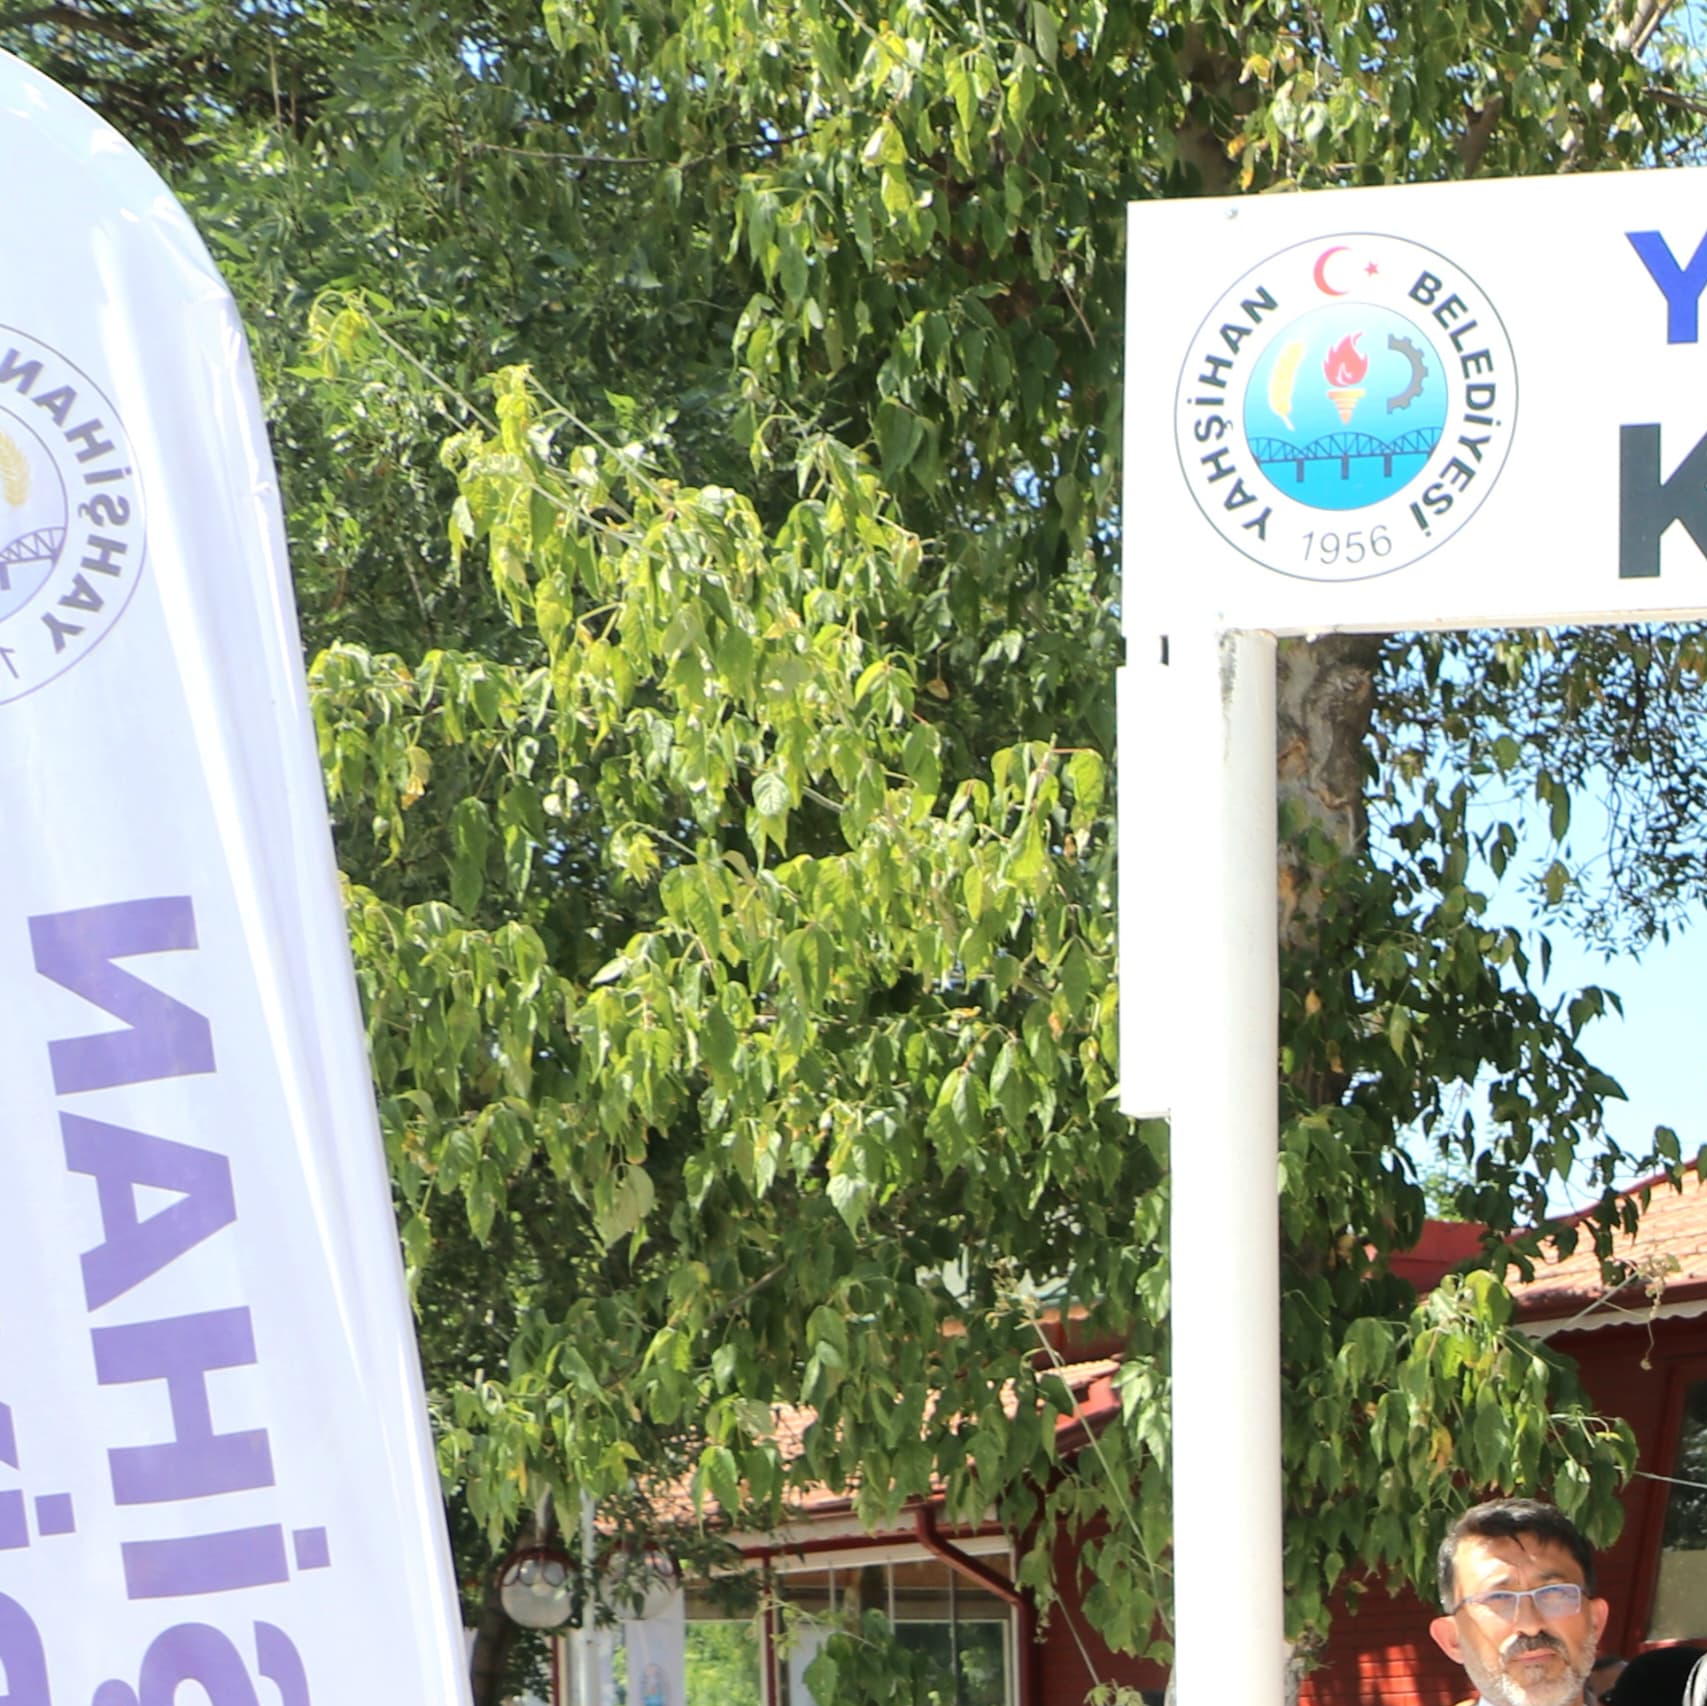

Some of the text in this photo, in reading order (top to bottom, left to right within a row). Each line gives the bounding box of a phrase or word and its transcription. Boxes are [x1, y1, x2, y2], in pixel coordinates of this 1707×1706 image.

[1186, 285, 1279, 542] YAHŞİHAN
[1407, 270, 1502, 537] BELEDİYESİ
[1301, 525, 1393, 565] 1956
